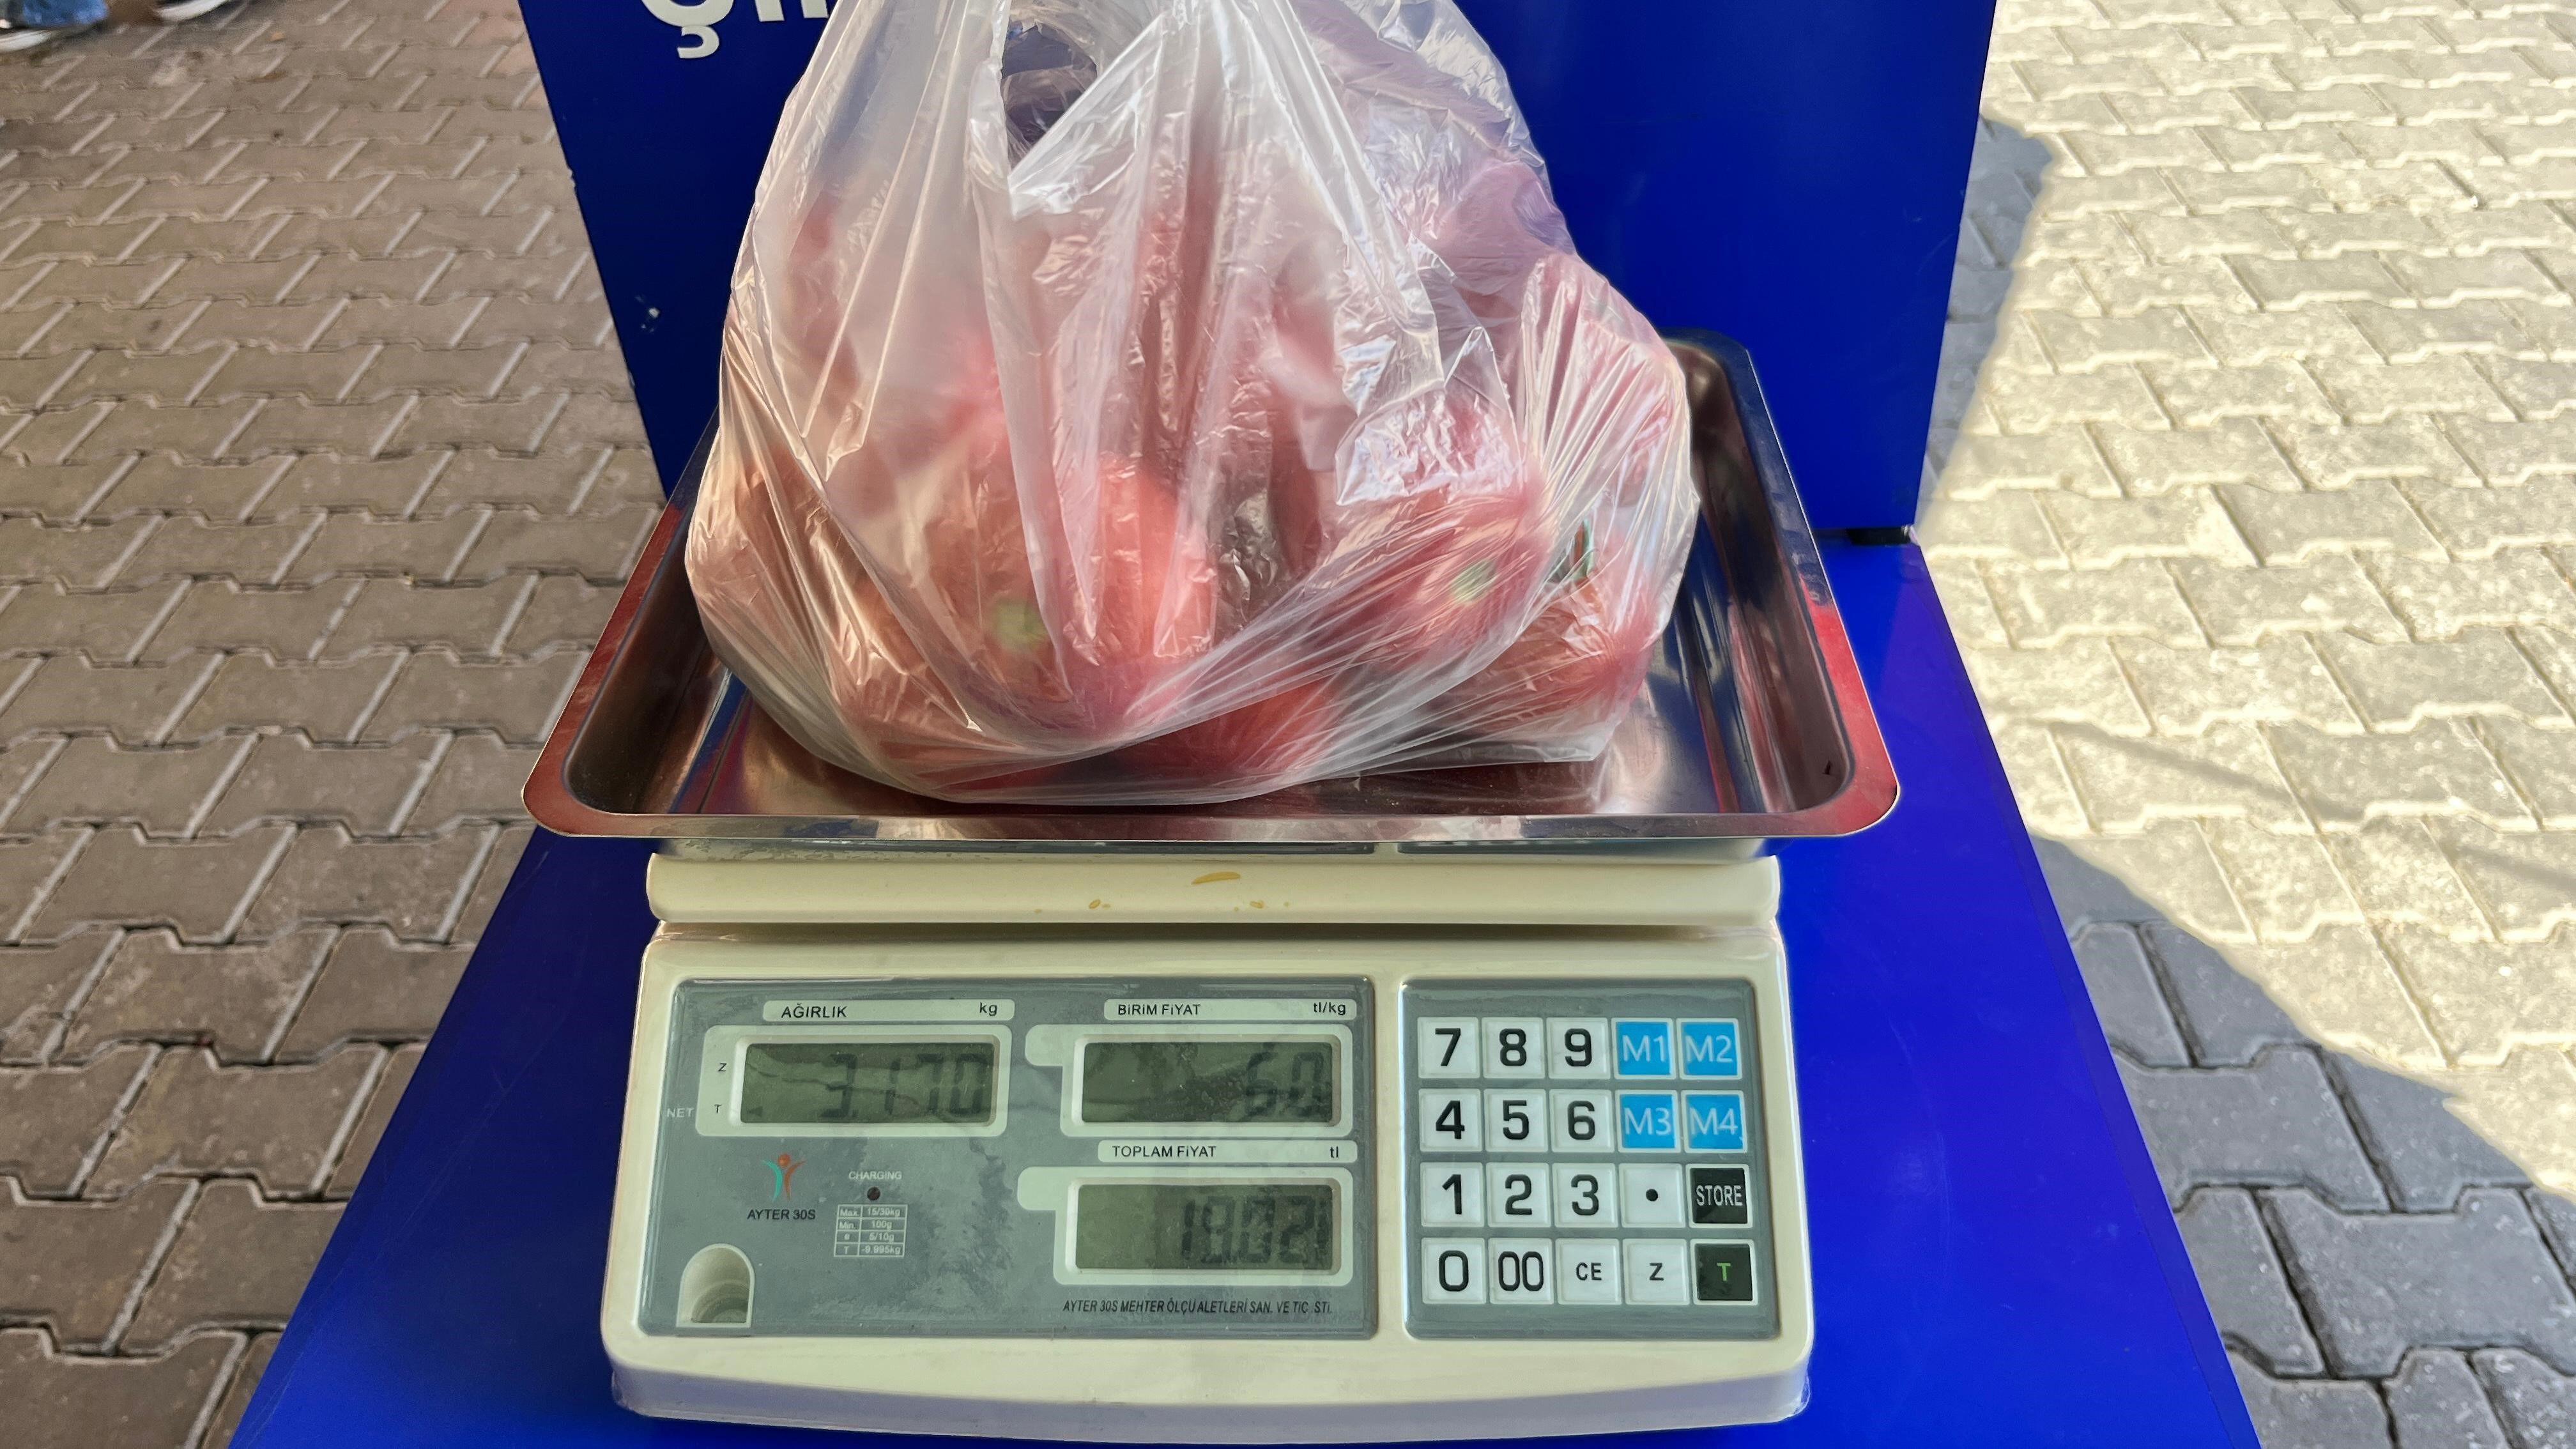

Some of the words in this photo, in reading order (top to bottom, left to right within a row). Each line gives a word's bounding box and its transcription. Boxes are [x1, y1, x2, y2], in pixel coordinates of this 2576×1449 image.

[781, 1002, 848, 1018] AĞIRLIK
[979, 1001, 998, 1016] kg
[1312, 1001, 1347, 1016] tl/kg
[1434, 1027, 1462, 1067] 7
[1499, 1027, 1527, 1067] 8
[1563, 1027, 1592, 1068] 9
[1621, 1034, 1666, 1062] M1
[1683, 1034, 1733, 1062] M2
[717, 1062, 728, 1073] Z
[666, 1107, 695, 1118] NET
[714, 1104, 723, 1114] T
[1435, 1100, 1466, 1140] 4
[1501, 1099, 1529, 1140] 5
[1567, 1100, 1596, 1141] 6
[1623, 1107, 1672, 1135] M3
[1689, 1107, 1738, 1135] M4
[1112, 1145, 1174, 1158] TOPLAM
[848, 1170, 903, 1180] CHARGING
[1441, 1174, 1462, 1215] 1
[1505, 1174, 1533, 1216] 2
[1570, 1174, 1600, 1216] 3
[1695, 1184, 1744, 1207] STORE
[746, 1209, 790, 1220] AYTER
[792, 1209, 816, 1220] 30S
[871, 1220, 893, 1231] 100g
[843, 1245, 850, 1255] T
[1438, 1250, 1469, 1292] 0
[1497, 1250, 1544, 1292] 00
[1575, 1262, 1602, 1282] CE
[1649, 1262, 1664, 1282] Z
[1717, 1262, 1731, 1282] T
[1063, 1300, 1098, 1312] AYTER
[1099, 1300, 1118, 1312] 30S
[1119, 1300, 1164, 1312] MEHTER
[1276, 1301, 1290, 1313] VE
